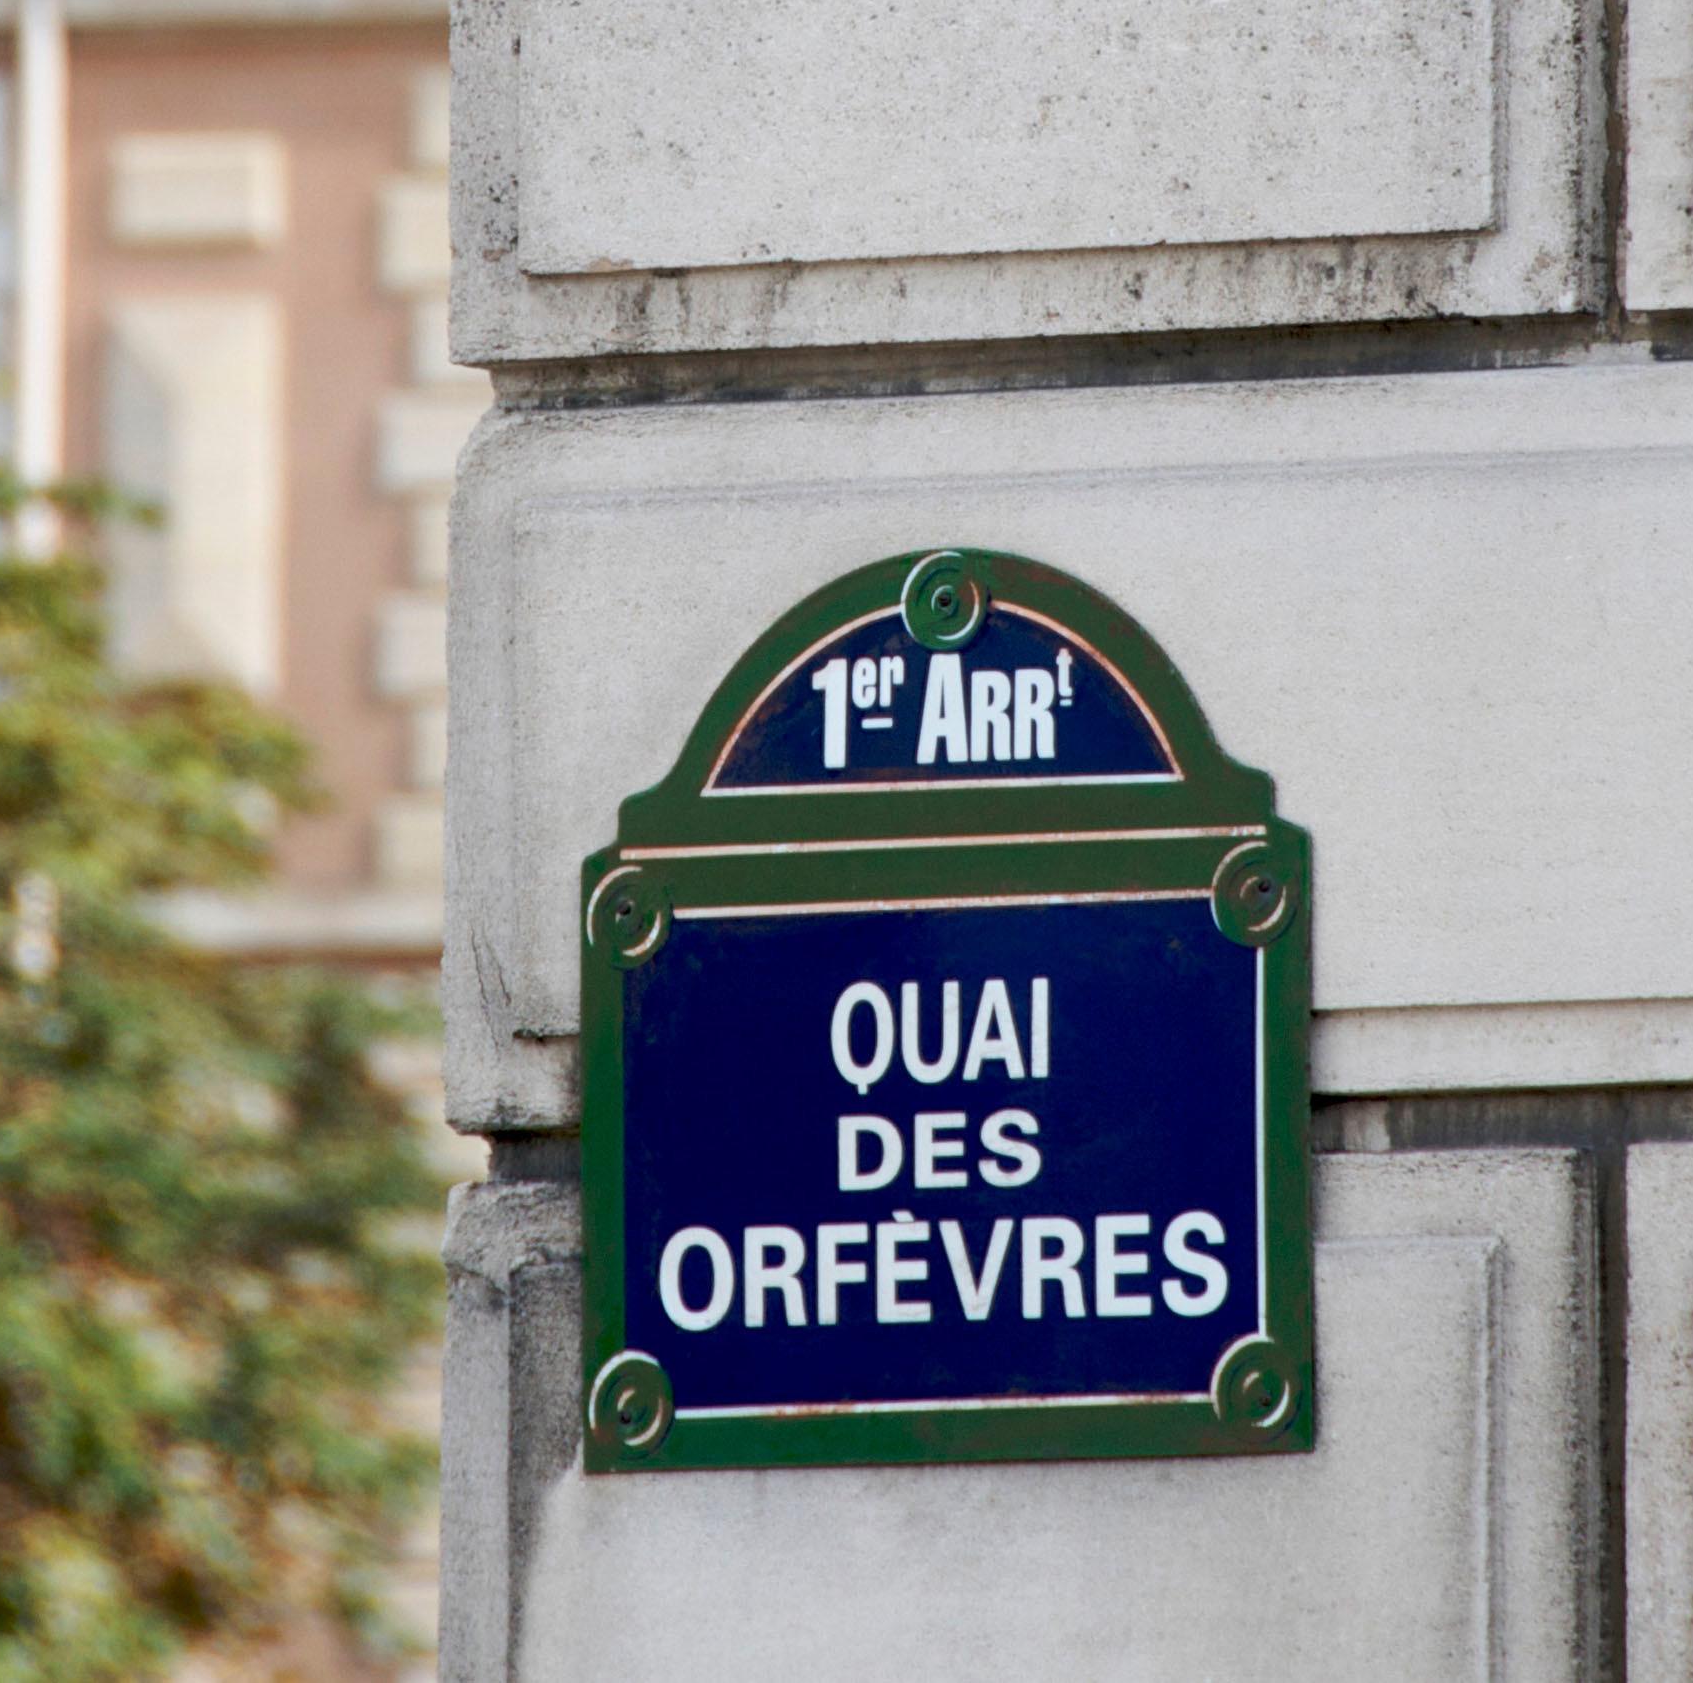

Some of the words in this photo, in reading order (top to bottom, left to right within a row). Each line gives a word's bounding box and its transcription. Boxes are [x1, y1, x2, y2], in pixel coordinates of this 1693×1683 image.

[831, 977, 1049, 1095] QUAI
[837, 1109, 1041, 1192] DES
[659, 1210, 1228, 1331] ORFÈVRES
